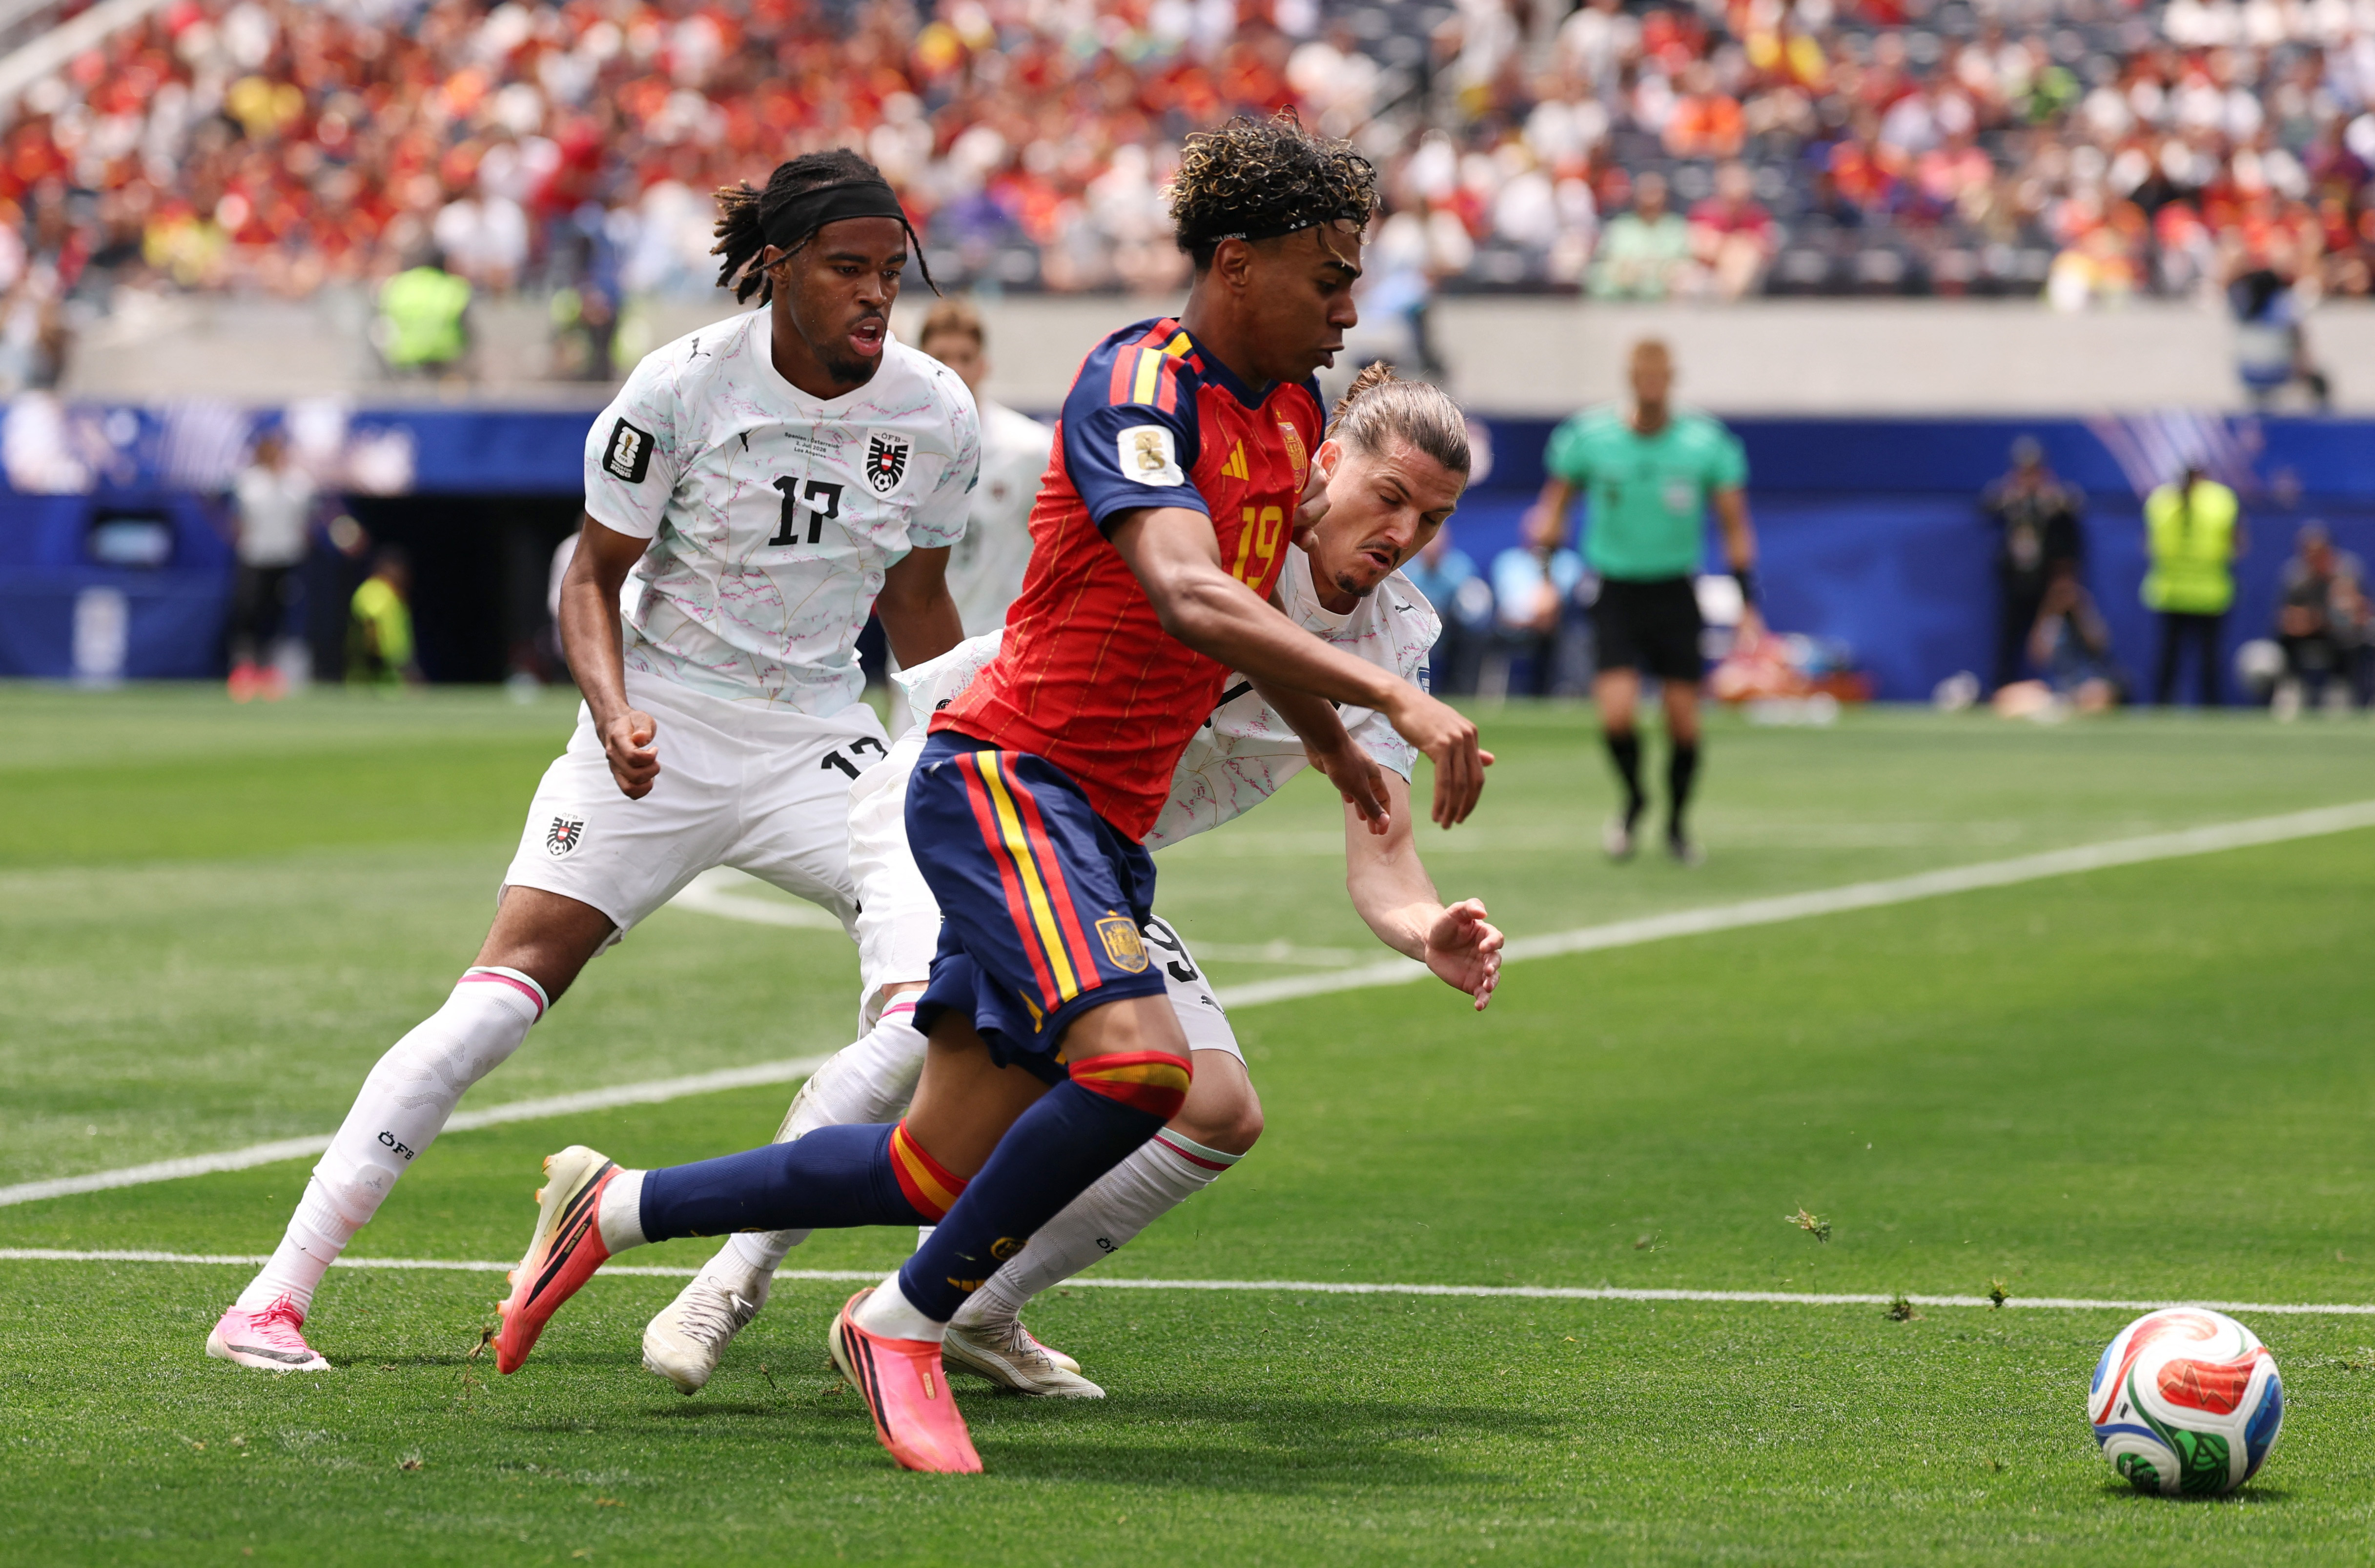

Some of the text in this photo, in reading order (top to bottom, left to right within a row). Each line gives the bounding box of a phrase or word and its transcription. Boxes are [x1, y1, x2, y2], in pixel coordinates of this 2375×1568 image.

[784, 432, 807, 441] Spanien
[810, 437, 839, 449] Österreich
[881, 432, 901, 443] ÖFB
[805, 449, 826, 458] Angeles
[610, 463, 632, 478] 2026
[768, 475, 845, 546] 17
[1232, 506, 1283, 590] 19
[1140, 916, 1199, 983] 9
[378, 1131, 414, 1160] ÖFB
